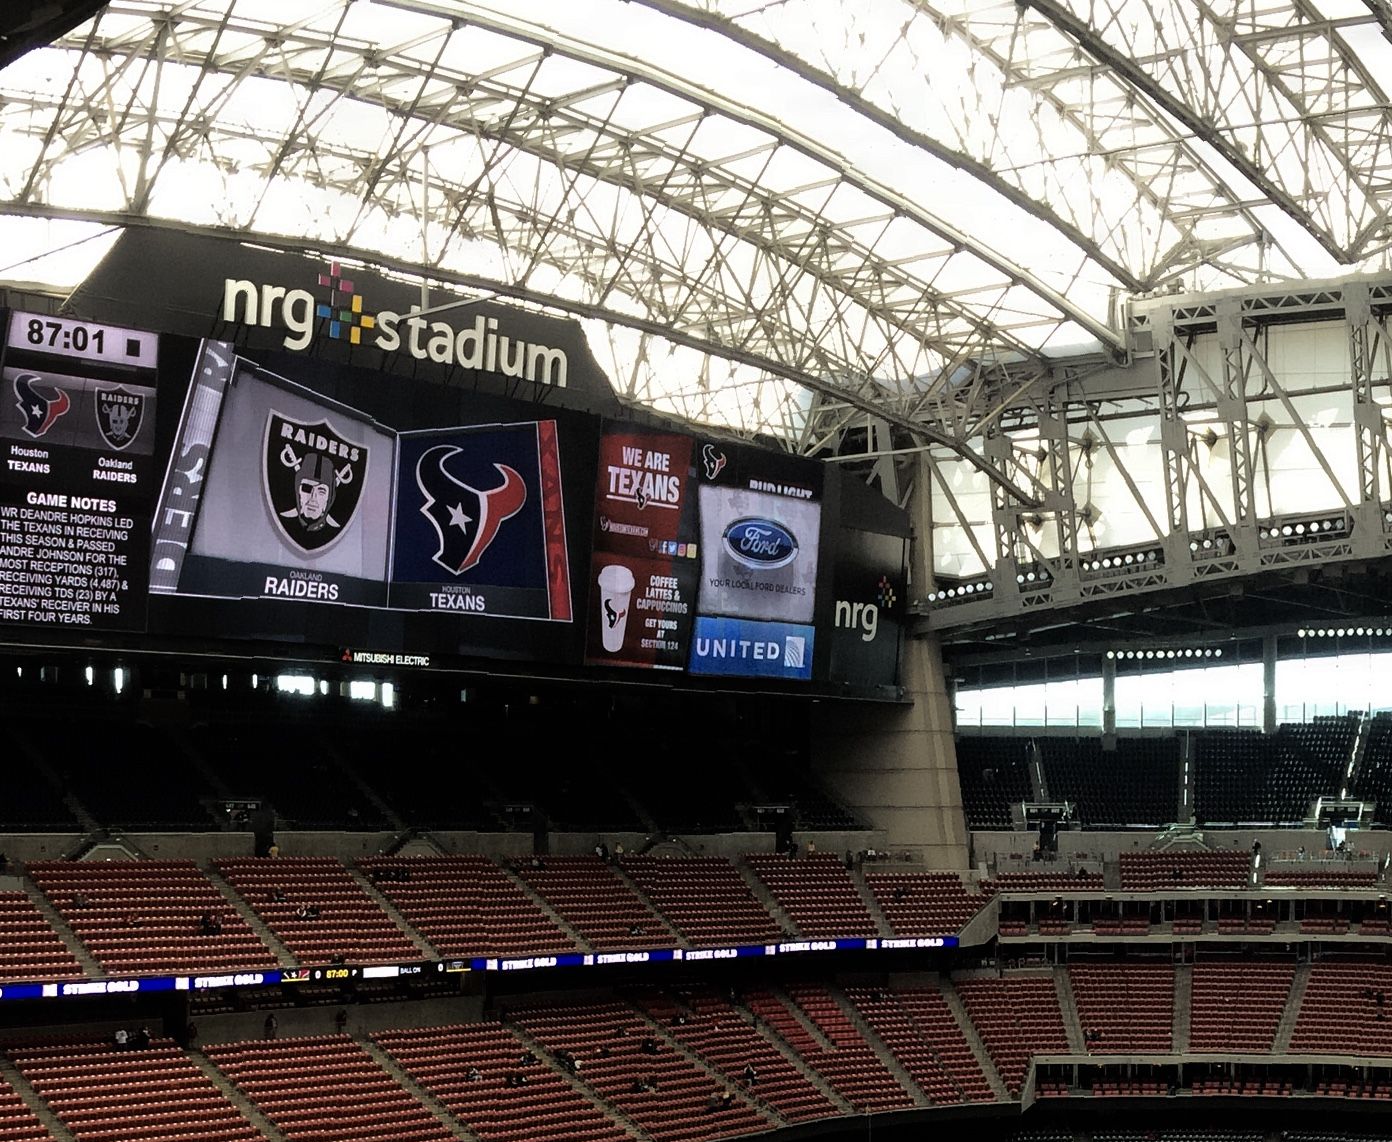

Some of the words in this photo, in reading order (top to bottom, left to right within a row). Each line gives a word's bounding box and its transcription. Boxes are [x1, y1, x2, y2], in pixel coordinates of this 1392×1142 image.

[27, 319, 104, 354] 87:01
[223, 278, 315, 351] nrg
[375, 305, 568, 389] stadium
[101, 392, 139, 405] RAIDERS
[281, 423, 360, 462] RAIDERS
[11, 445, 49, 459] Houston
[622, 446, 644, 466] WE
[646, 451, 670, 472] ARE
[7, 460, 50, 474] TEXANS
[98, 457, 133, 470] Oakland
[93, 470, 137, 484] RAIDERS
[607, 465, 680, 503] TEXANS
[27, 492, 67, 507] GAME
[71, 496, 116, 512] NOTES
[1, 506, 18, 518] WR
[20, 508, 68, 523] DEANDRE
[70, 513, 113, 527] HOPKINS
[115, 518, 134, 528] LED
[0, 520, 20, 531] THE
[23, 521, 62, 535] TEXANS
[64, 526, 74, 536] IN
[76, 527, 128, 541] RECEIVING
[0, 532, 23, 544] THIS
[25, 535, 66, 548] SEASON
[68, 539, 75, 549] &
[76, 539, 115, 552] PASSED
[740, 526, 781, 558] Ford
[0, 545, 34, 558] ANDRE
[36, 549, 84, 562] JOHNSON
[86, 553, 106, 564] FOR
[108, 555, 127, 565] THE
[0, 558, 28, 569] MOST
[30, 561, 93, 575] RECEPTIONS
[0, 571, 52, 584] RECEIVING
[55, 575, 88, 587] YARDS
[121, 580, 128, 590] &
[289, 570, 323, 582] OAKLAND
[650, 574, 678, 589] COFFEE
[0, 583, 52, 597] RECEIVING
[54, 588, 74, 598] TDS
[76, 590, 93, 601] (23)
[95, 591, 108, 601] BY
[110, 592, 117, 601] A
[264, 577, 339, 600] RAIDERS
[442, 585, 471, 594] HOUSTON
[645, 586, 672, 601] LATTES
[674, 590, 680, 601] &
[709, 578, 730, 589] YOUR
[755, 581, 775, 593] FORD
[775, 584, 806, 597] DEALERS
[41, 600, 90, 612] RECEIVER
[92, 603, 102, 613] IN
[104, 604, 120, 614] HIS
[430, 592, 486, 612] TEXANS
[636, 598, 688, 615] CAPPUCCINOS
[28, 611, 56, 622] FOUR
[58, 613, 93, 625] YEARS.
[645, 618, 656, 630] GET
[657, 619, 678, 631] YOURS
[835, 600, 878, 642] nrg
[656, 629, 665, 639] AT
[640, 638, 665, 650] SECTION
[667, 640, 679, 650] 124
[696, 638, 780, 661] UNITED
[353, 651, 394, 665] MITSUBISHI
[396, 654, 430, 667] ELECTRIC
[811, 941, 836, 951] GOLD
[917, 938, 944, 947] GOLD
